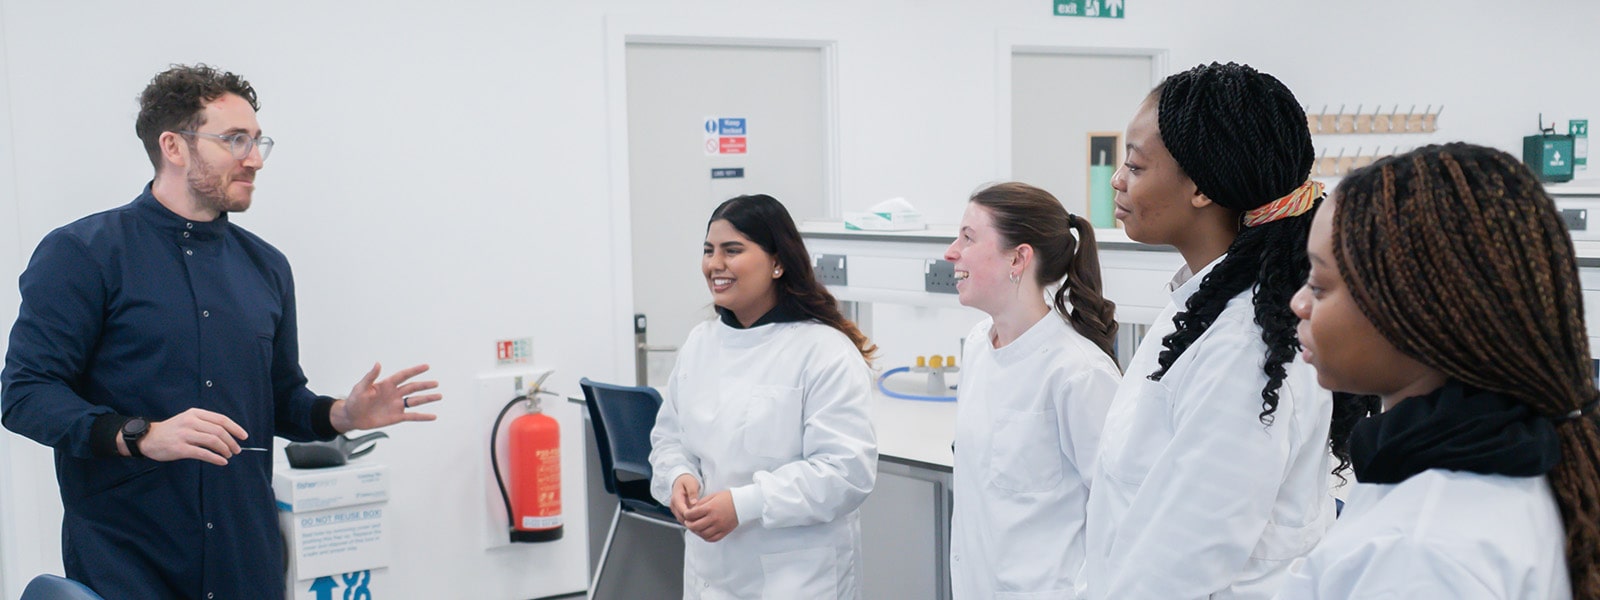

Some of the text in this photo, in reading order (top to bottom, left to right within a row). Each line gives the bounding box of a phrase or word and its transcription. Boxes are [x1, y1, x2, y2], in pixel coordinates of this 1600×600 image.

[1058, 3, 1077, 14] exit
[301, 518, 314, 527] DO
[315, 515, 332, 525] NOT
[334, 511, 359, 521] REUSE
